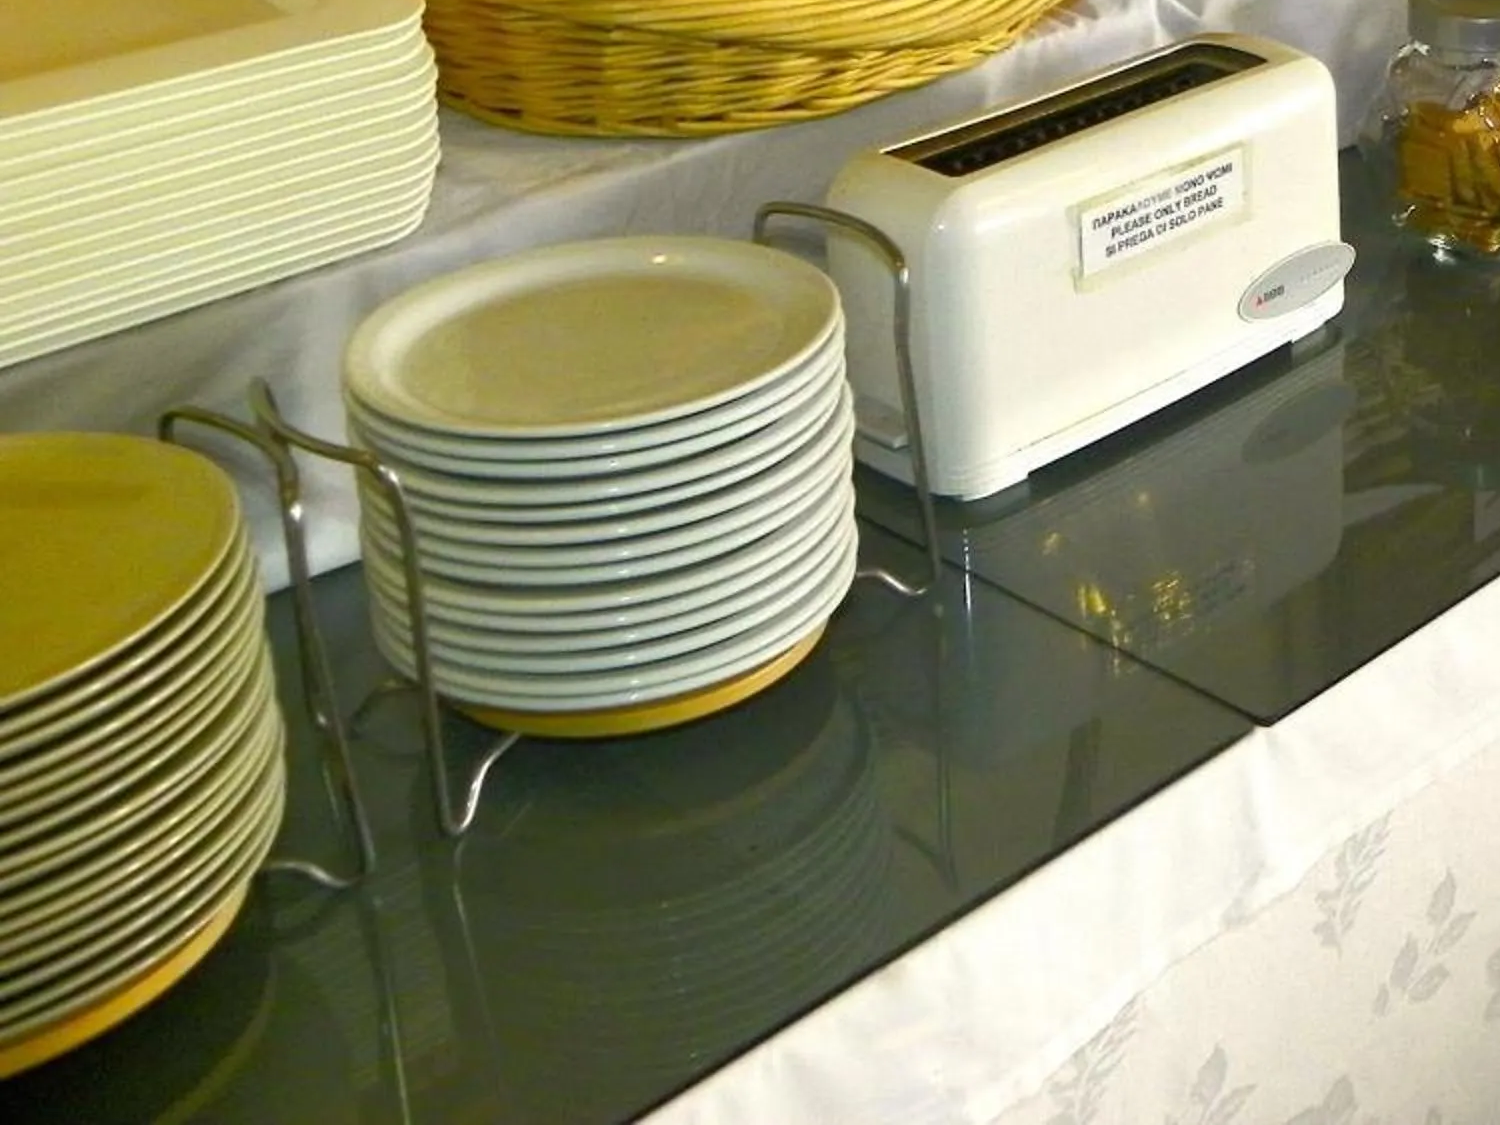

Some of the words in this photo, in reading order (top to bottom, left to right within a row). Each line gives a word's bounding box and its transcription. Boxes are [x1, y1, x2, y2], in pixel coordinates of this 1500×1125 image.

[1111, 212, 1152, 238] PLEASE
[1153, 200, 1182, 220] ONLY
[1183, 184, 1218, 208] BREAD
[1169, 210, 1197, 230] SOLO
[1198, 196, 1224, 217] PANE
